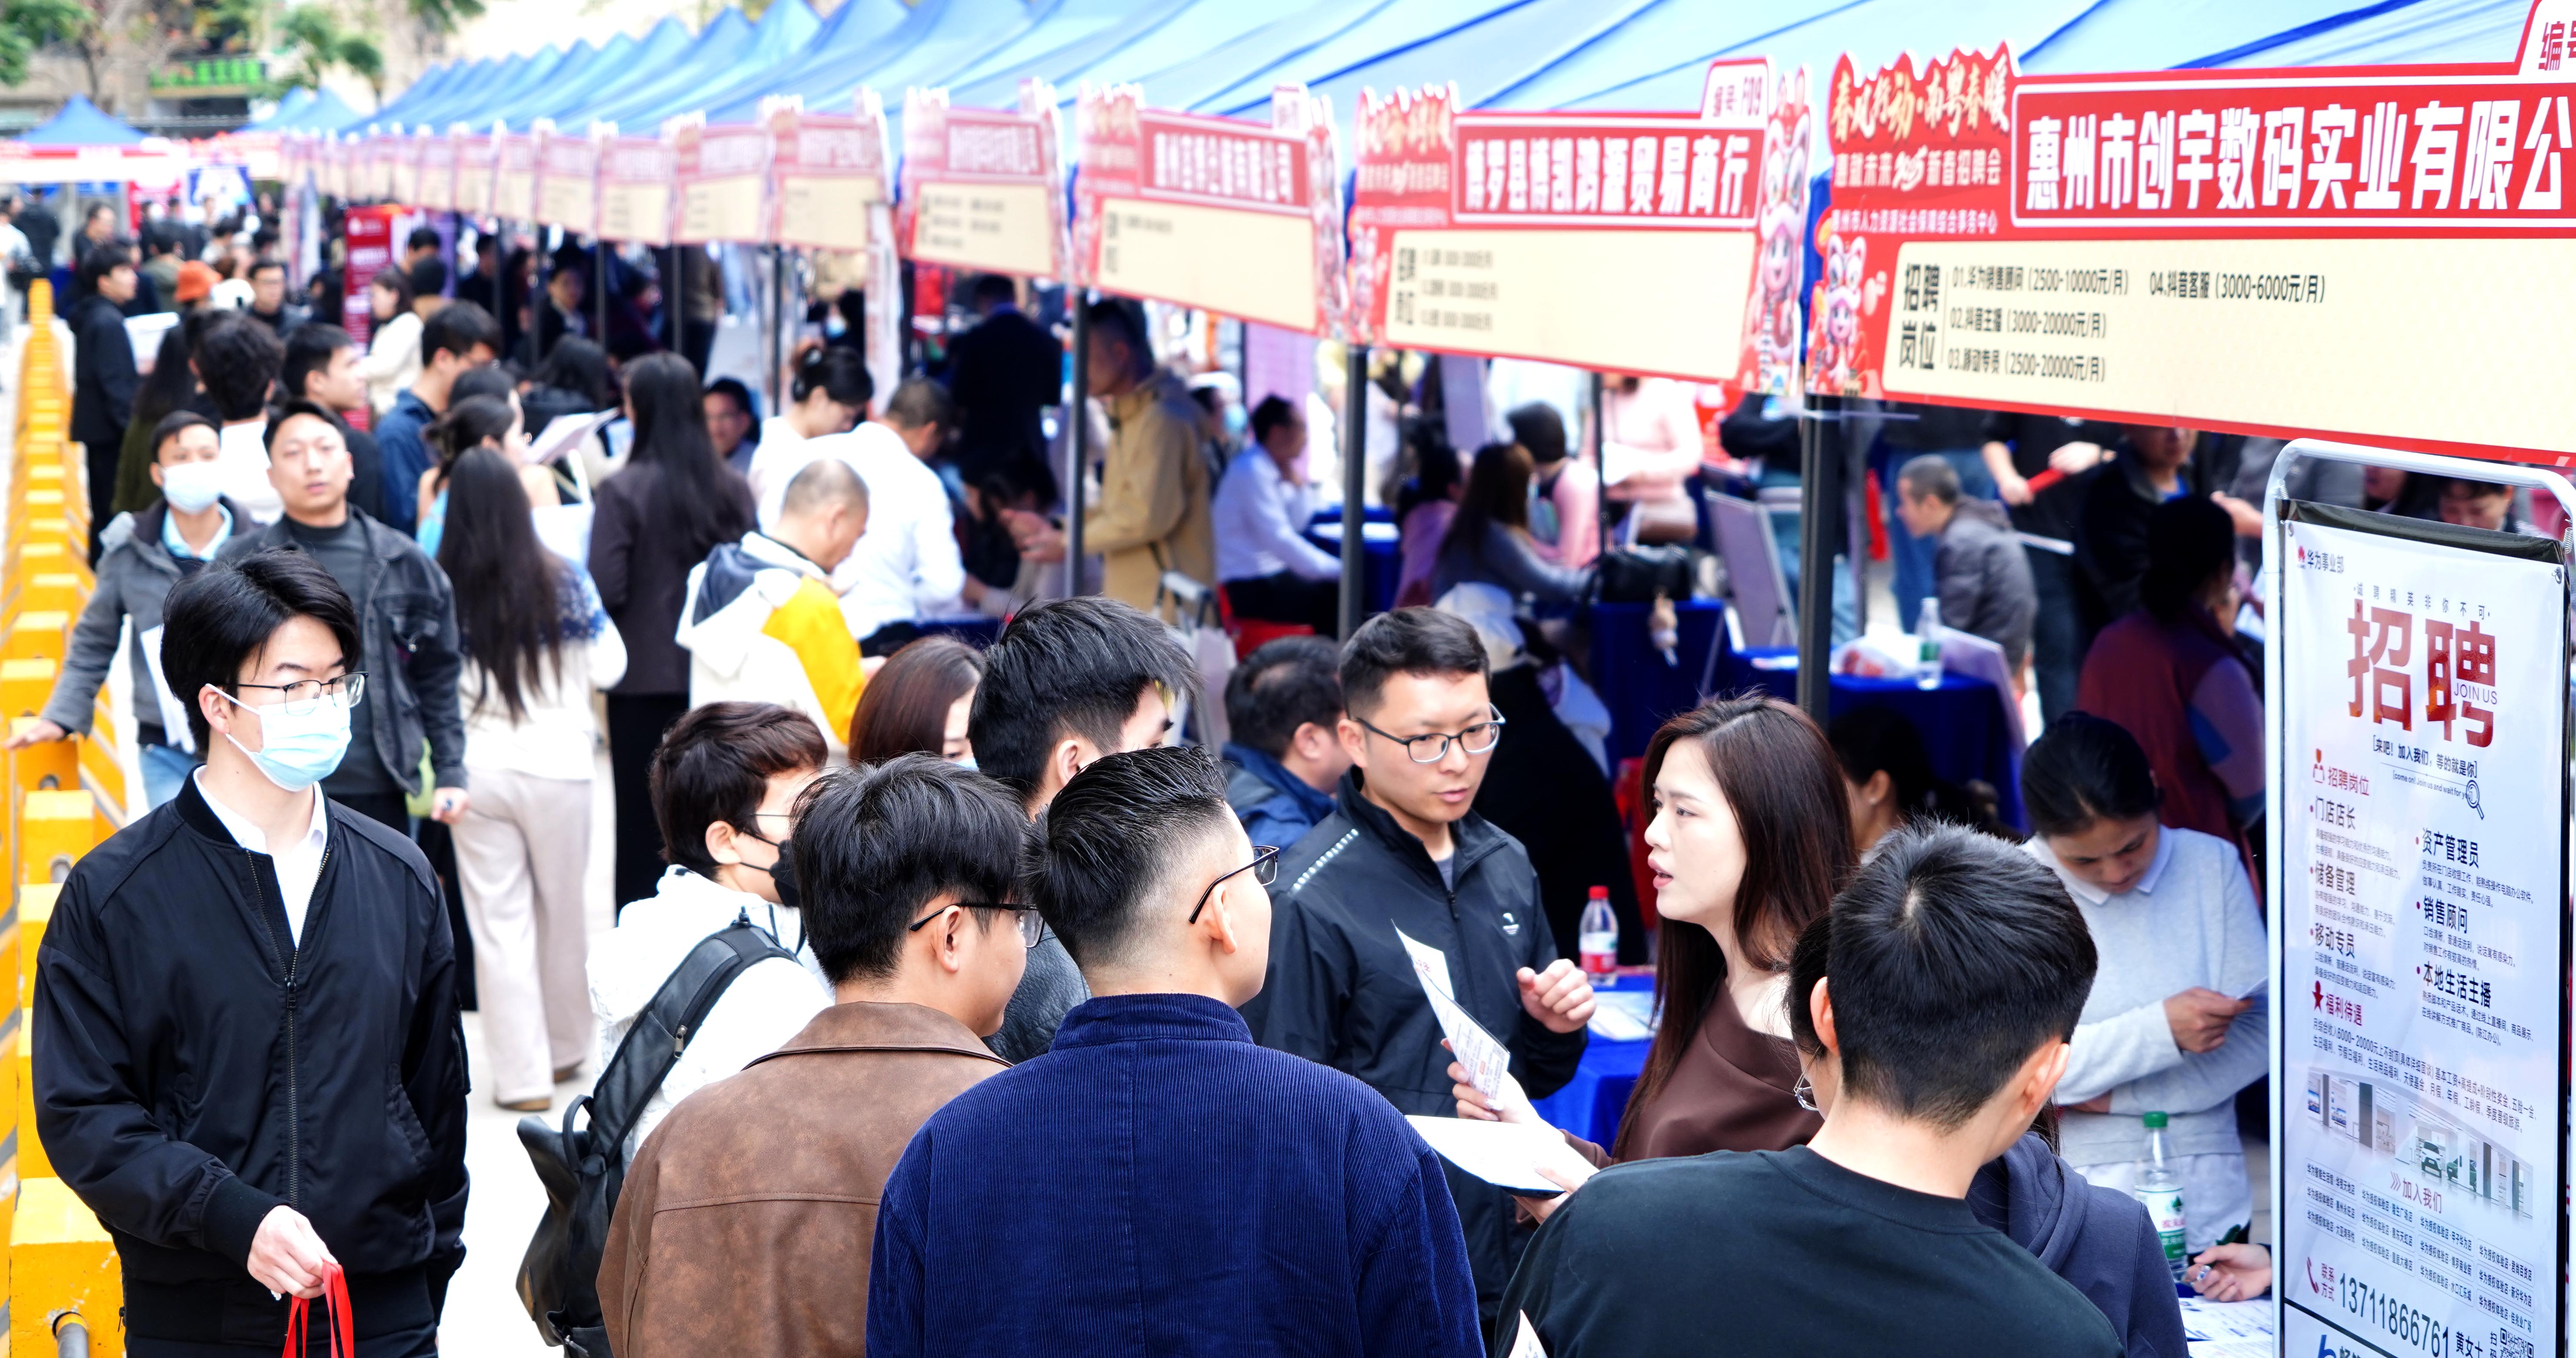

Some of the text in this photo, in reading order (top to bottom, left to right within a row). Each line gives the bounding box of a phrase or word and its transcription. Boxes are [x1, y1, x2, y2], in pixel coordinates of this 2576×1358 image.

[2024, 96, 2573, 210] 惠州市创宇数码实业有限公
[1903, 263, 1940, 312] 招聘
[1899, 319, 1936, 370] 岗位
[2307, 549, 2344, 574] 华为事业部
[2348, 598, 2496, 748] 招聘
[2453, 681, 2498, 706] JOIN US
[2328, 766, 2370, 797] 招聘岗位
[2315, 795, 2356, 830] 门店店长
[2422, 827, 2479, 869] 资产管理员
[2315, 861, 2355, 896] 储备管理
[2423, 895, 2468, 934] 销售顾问
[2315, 922, 2355, 959] 移动专员
[2423, 961, 2492, 1009] 本地生活主播
[2326, 993, 2362, 1026] 福利待遇
[2402, 1177, 2442, 1214] 加入我们
[2321, 1263, 2335, 1283] 联系
[2321, 1282, 2334, 1302] 方式
[2339, 1273, 2449, 1358] 13711866761
